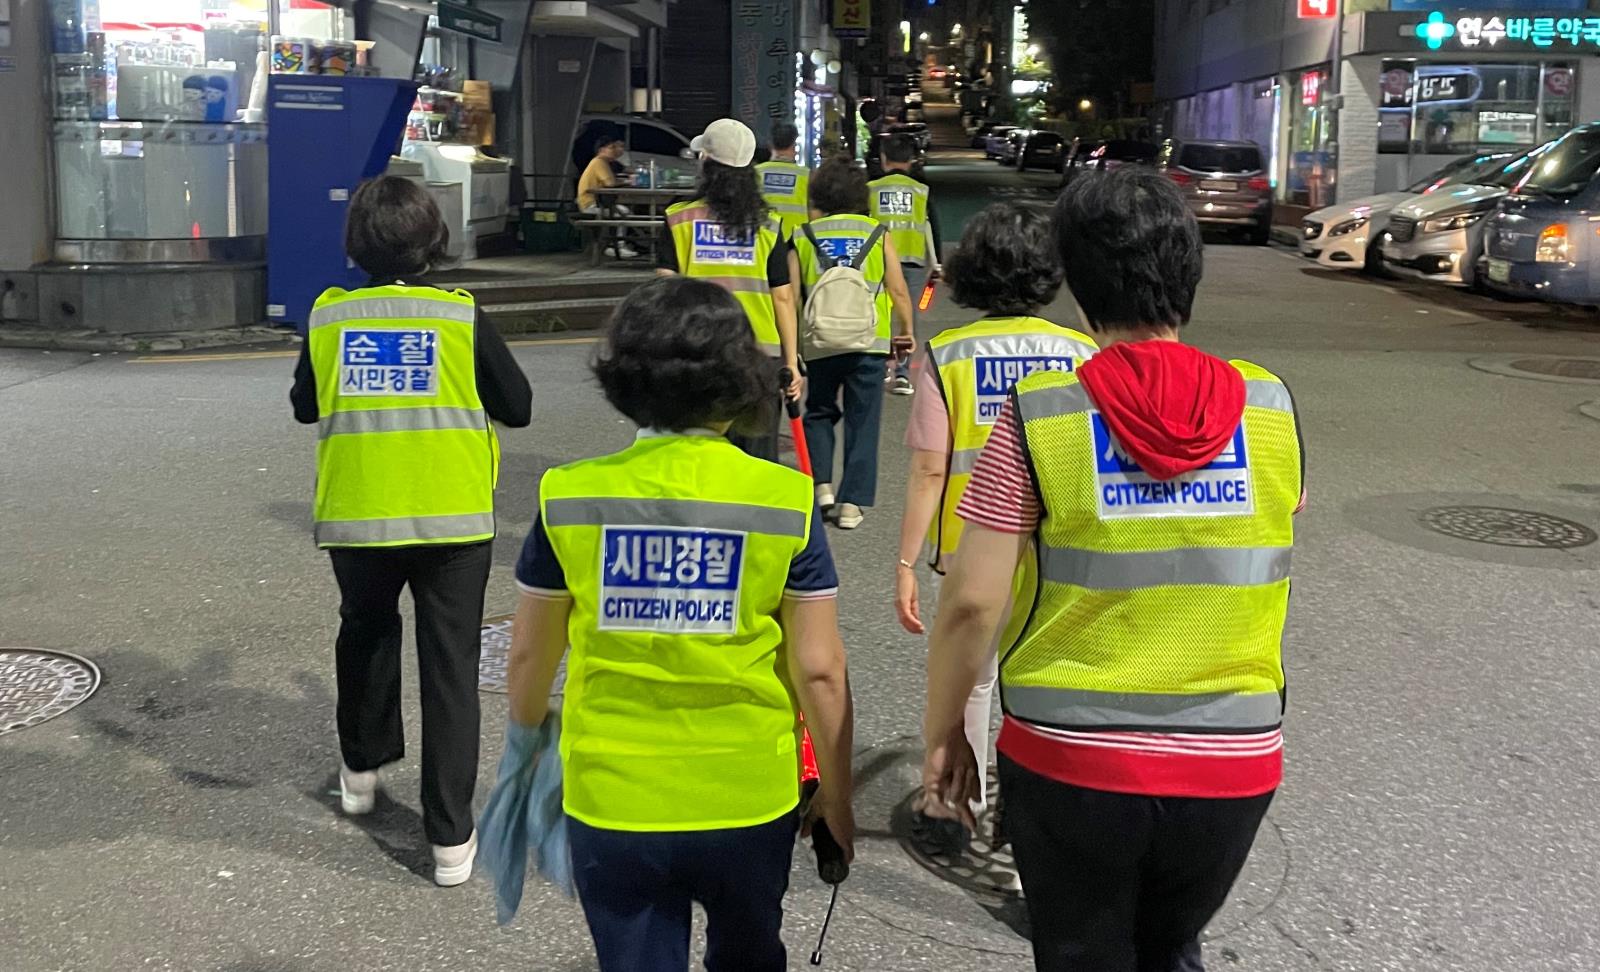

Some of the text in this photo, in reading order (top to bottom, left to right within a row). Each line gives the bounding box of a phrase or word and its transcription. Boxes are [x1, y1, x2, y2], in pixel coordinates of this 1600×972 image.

[881, 192, 912, 205] 시민
[345, 369, 432, 392] 시민경찰
[1103, 480, 1247, 506] CITIZEN POLICE
[611, 535, 736, 584] 시민경찰
[604, 596, 734, 622] CITIZEN POLICE
